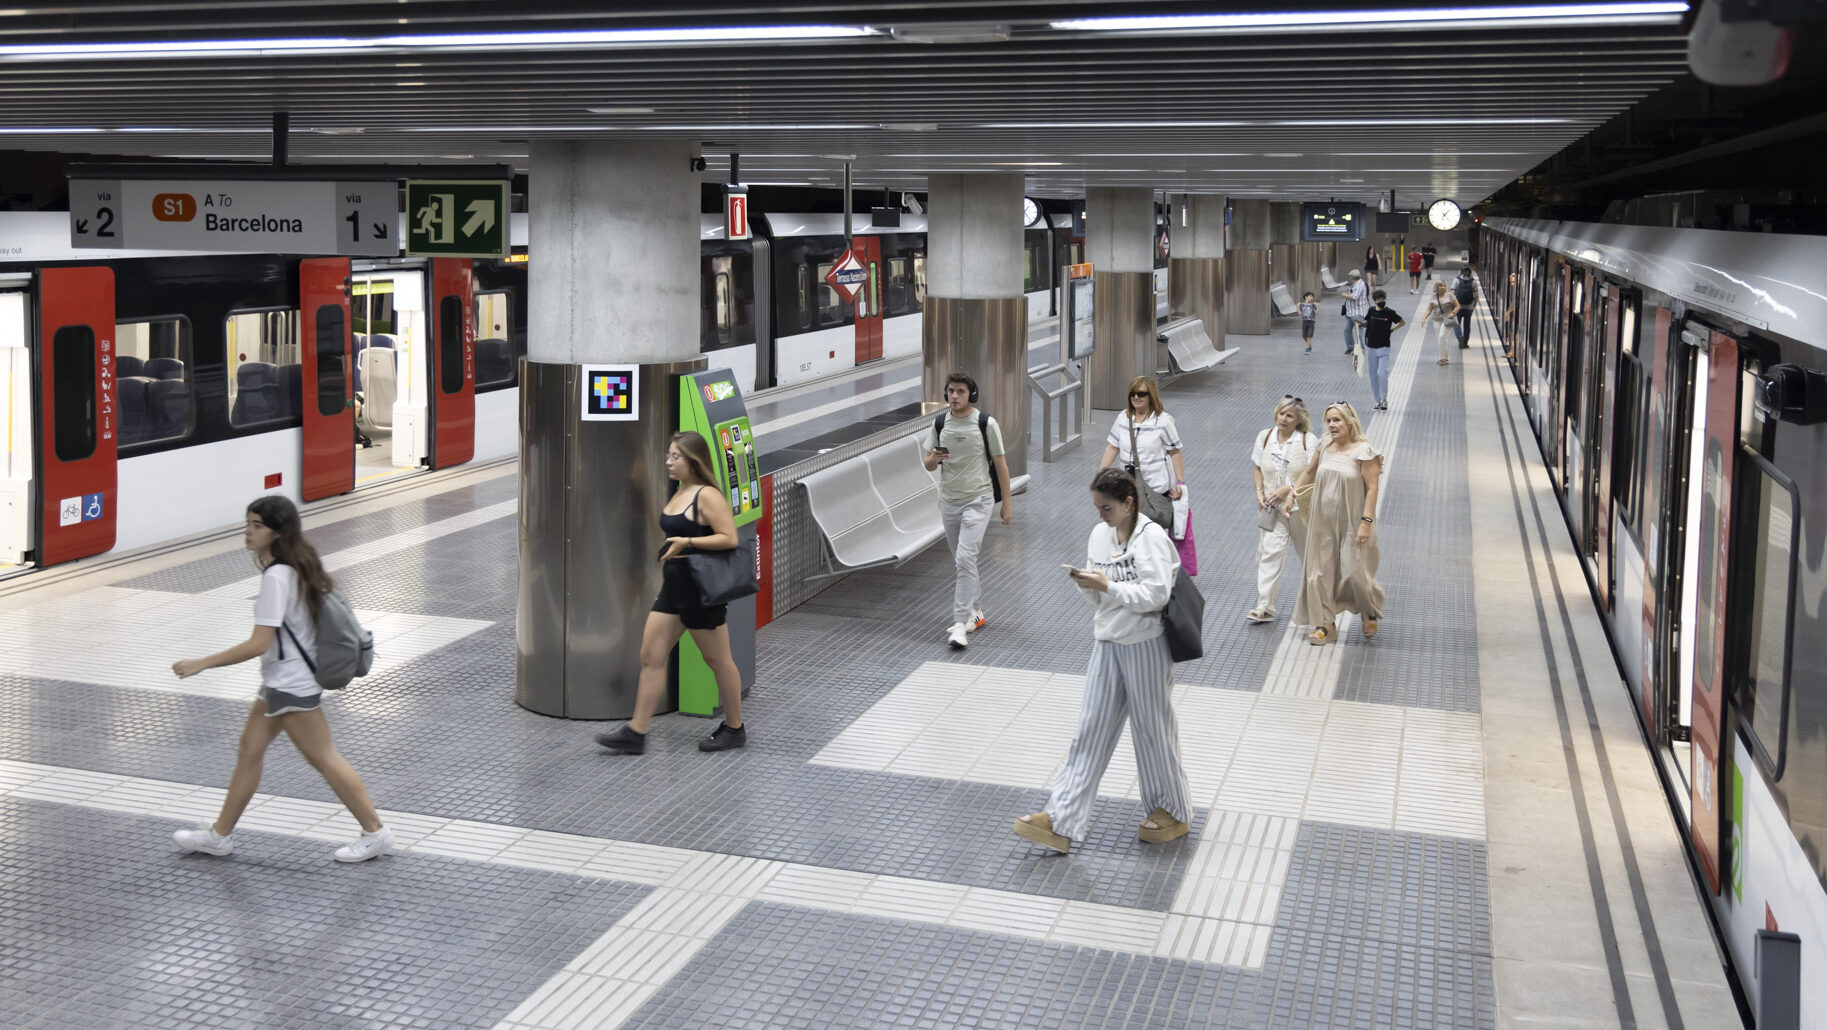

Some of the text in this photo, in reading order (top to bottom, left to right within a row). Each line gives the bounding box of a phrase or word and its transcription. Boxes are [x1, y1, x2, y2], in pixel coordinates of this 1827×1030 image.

[97, 191, 111, 201] via
[204, 194, 232, 207] A To
[346, 193, 362, 203] via
[164, 198, 184, 216] S1
[96, 207, 115, 237] 2
[205, 213, 303, 232] Barcelona
[346, 210, 360, 242] 1
